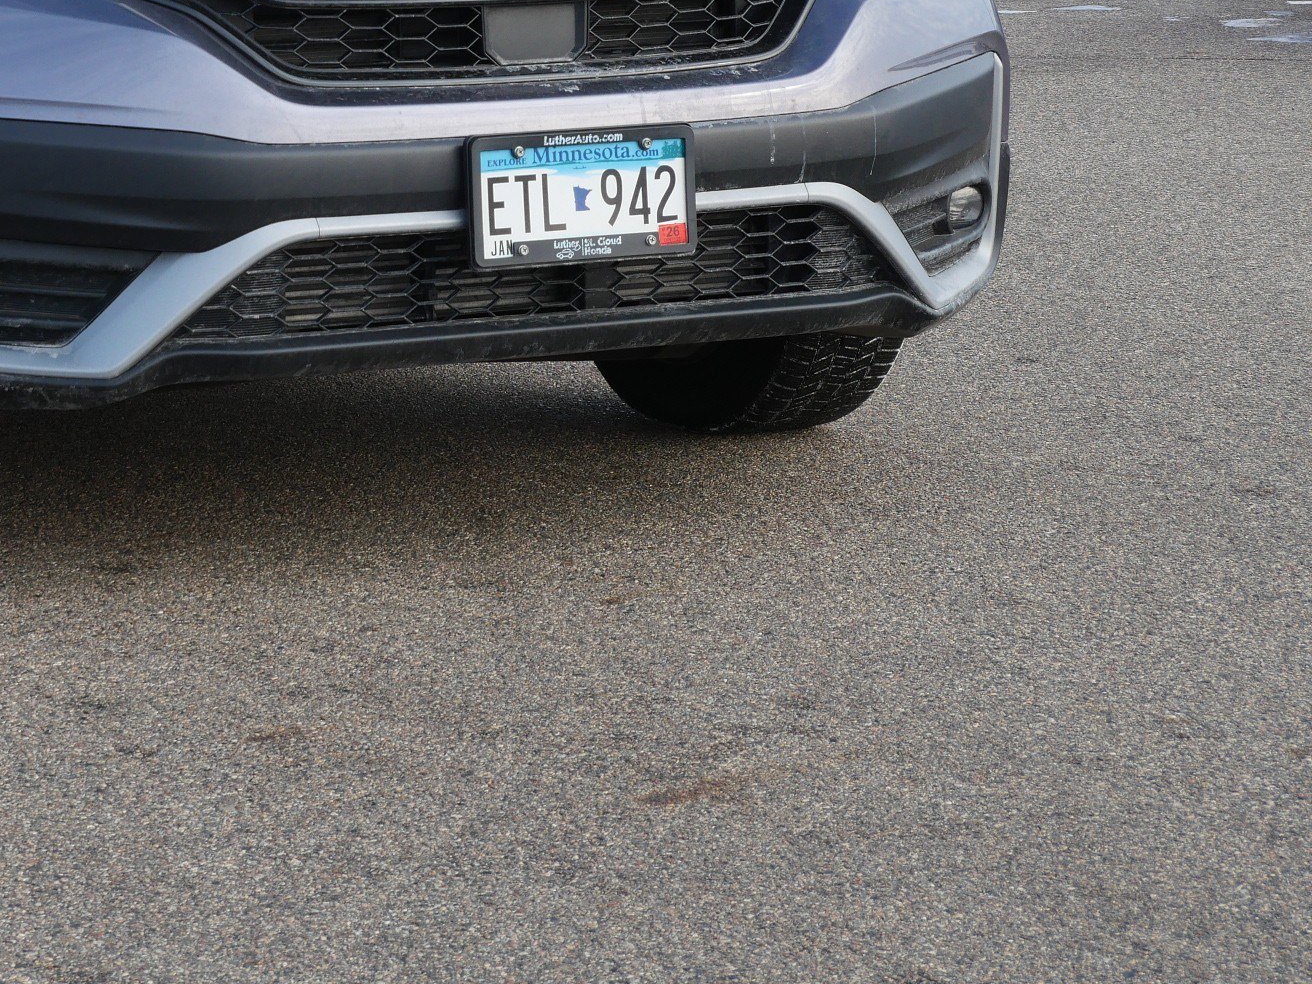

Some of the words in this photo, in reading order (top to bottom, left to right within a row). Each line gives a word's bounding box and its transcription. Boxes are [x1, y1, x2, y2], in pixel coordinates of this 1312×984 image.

[543, 133, 624, 146] LutherAuto.com
[487, 156, 527, 167] EXPLORE
[487, 173, 567, 236] ETL
[600, 165, 678, 227] 942
[553, 239, 581, 250] Luther
[597, 235, 622, 246] Cloud
[491, 239, 513, 257] JAN
[584, 246, 612, 256] Honda
